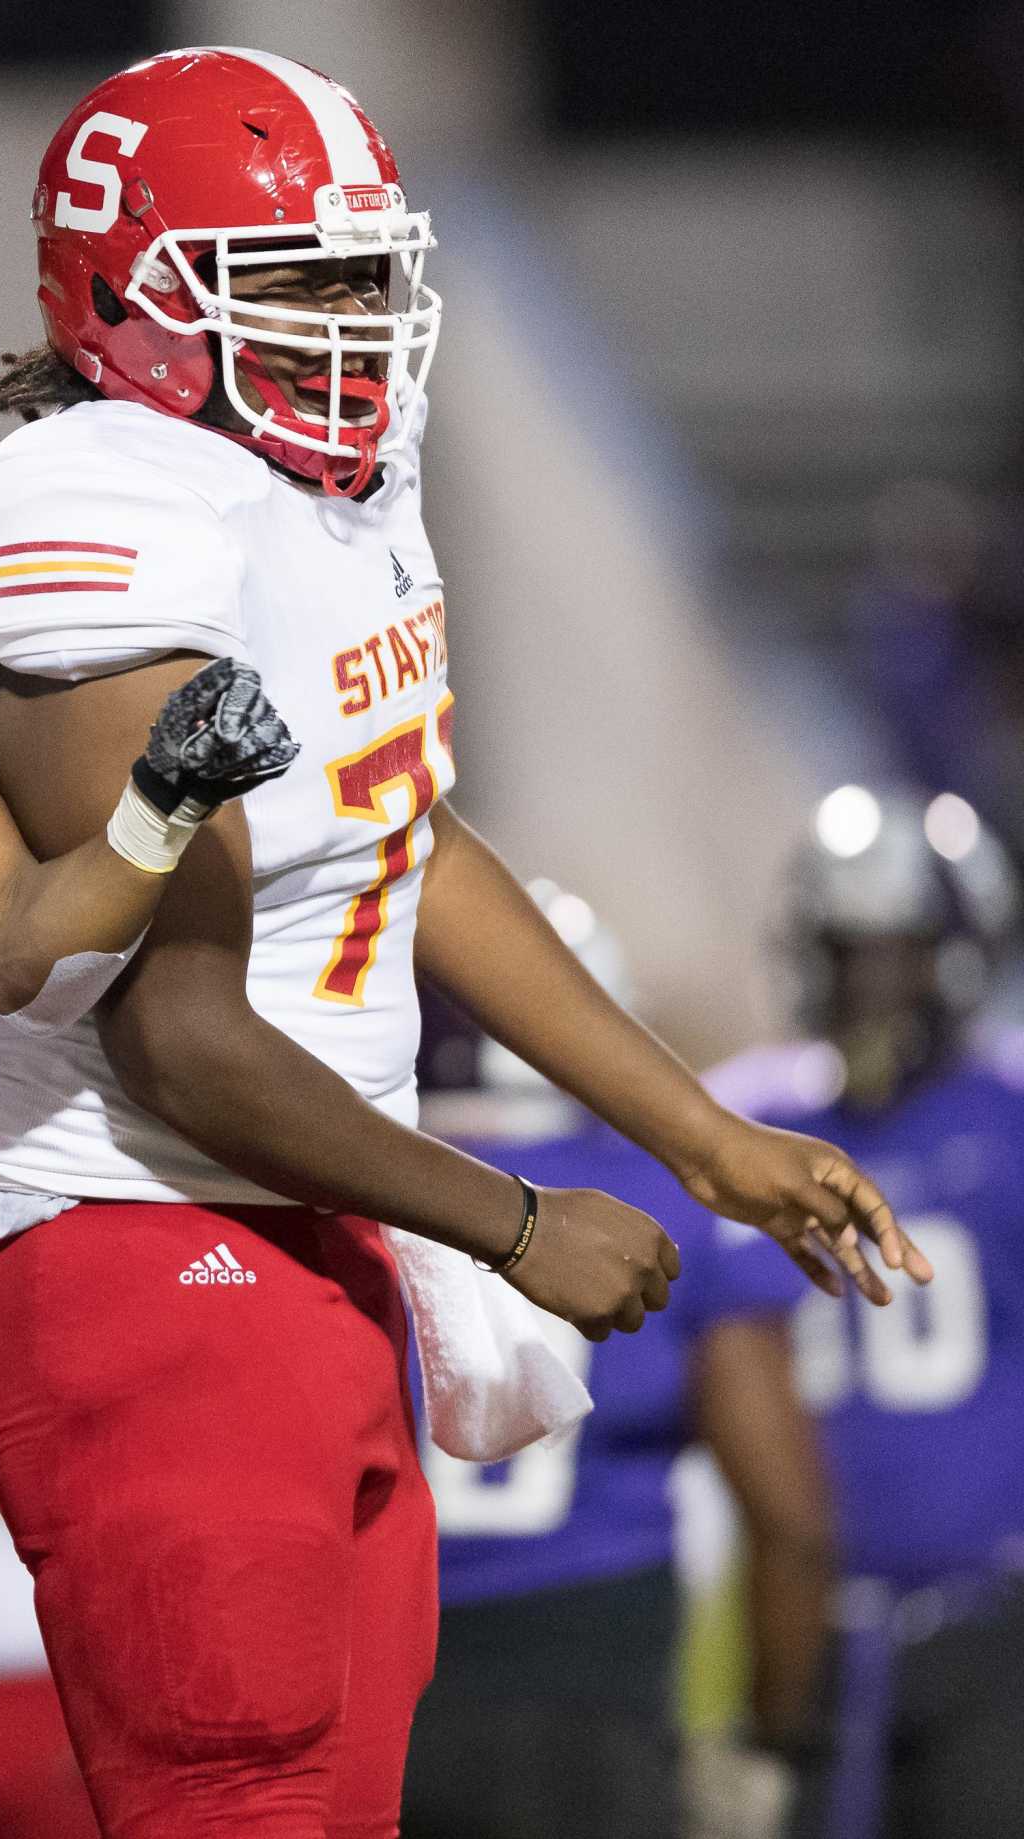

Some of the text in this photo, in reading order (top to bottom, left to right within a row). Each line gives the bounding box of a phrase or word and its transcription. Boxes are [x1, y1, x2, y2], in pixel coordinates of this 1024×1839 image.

[55, 111, 148, 234] S
[346, 192, 388, 209] TAFFORD
[514, 1214, 535, 1256] Riches
[178, 1267, 257, 1285] adidas
